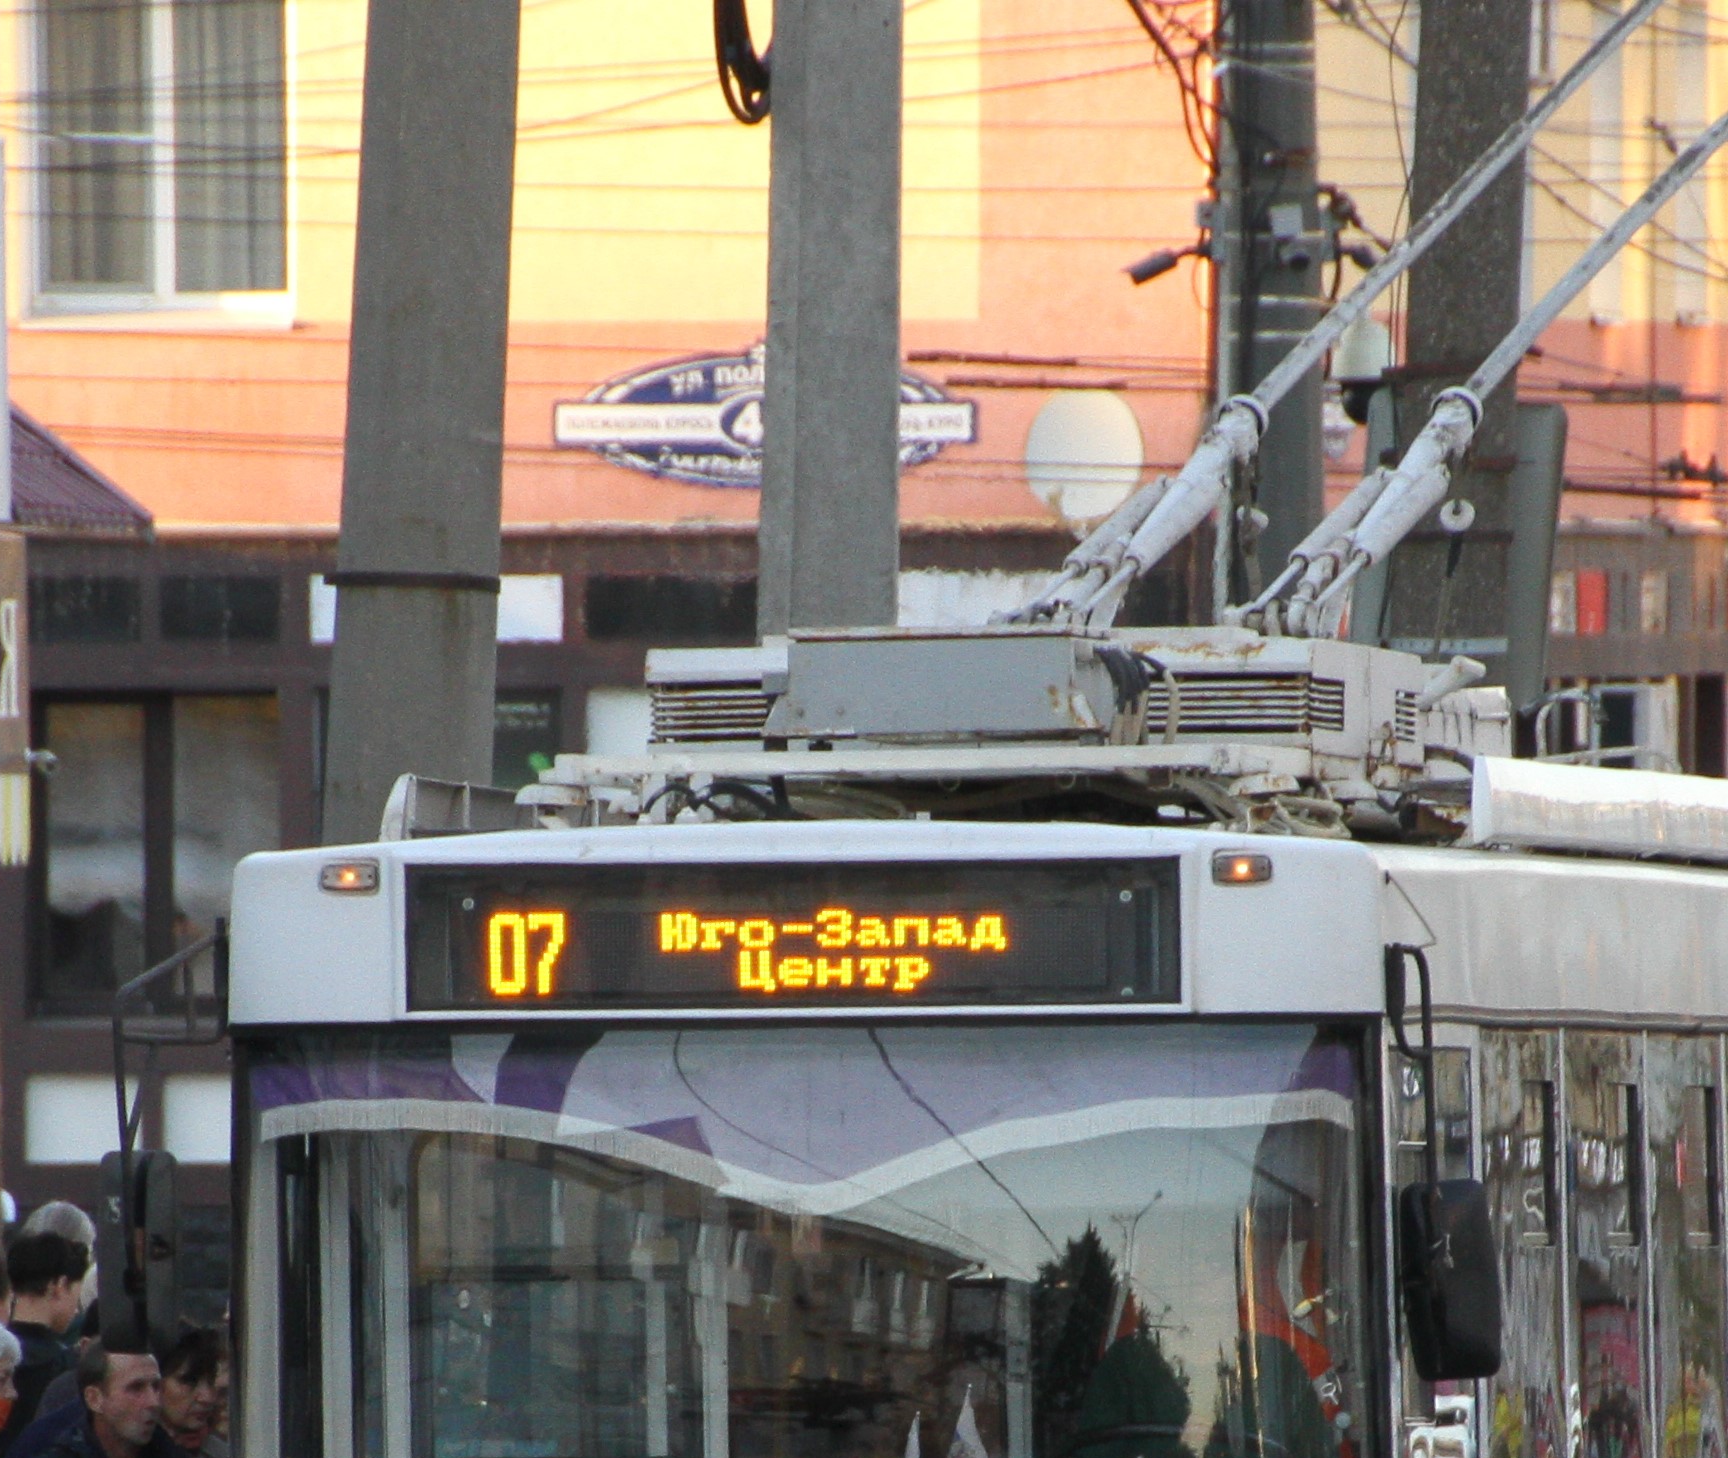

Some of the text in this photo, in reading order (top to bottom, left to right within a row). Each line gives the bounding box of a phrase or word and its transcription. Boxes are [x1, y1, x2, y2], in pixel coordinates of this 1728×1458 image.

[660, 908, 1007, 952] Юго-Запад
[488, 912, 565, 994] 07
[738, 949, 930, 992] Центр
